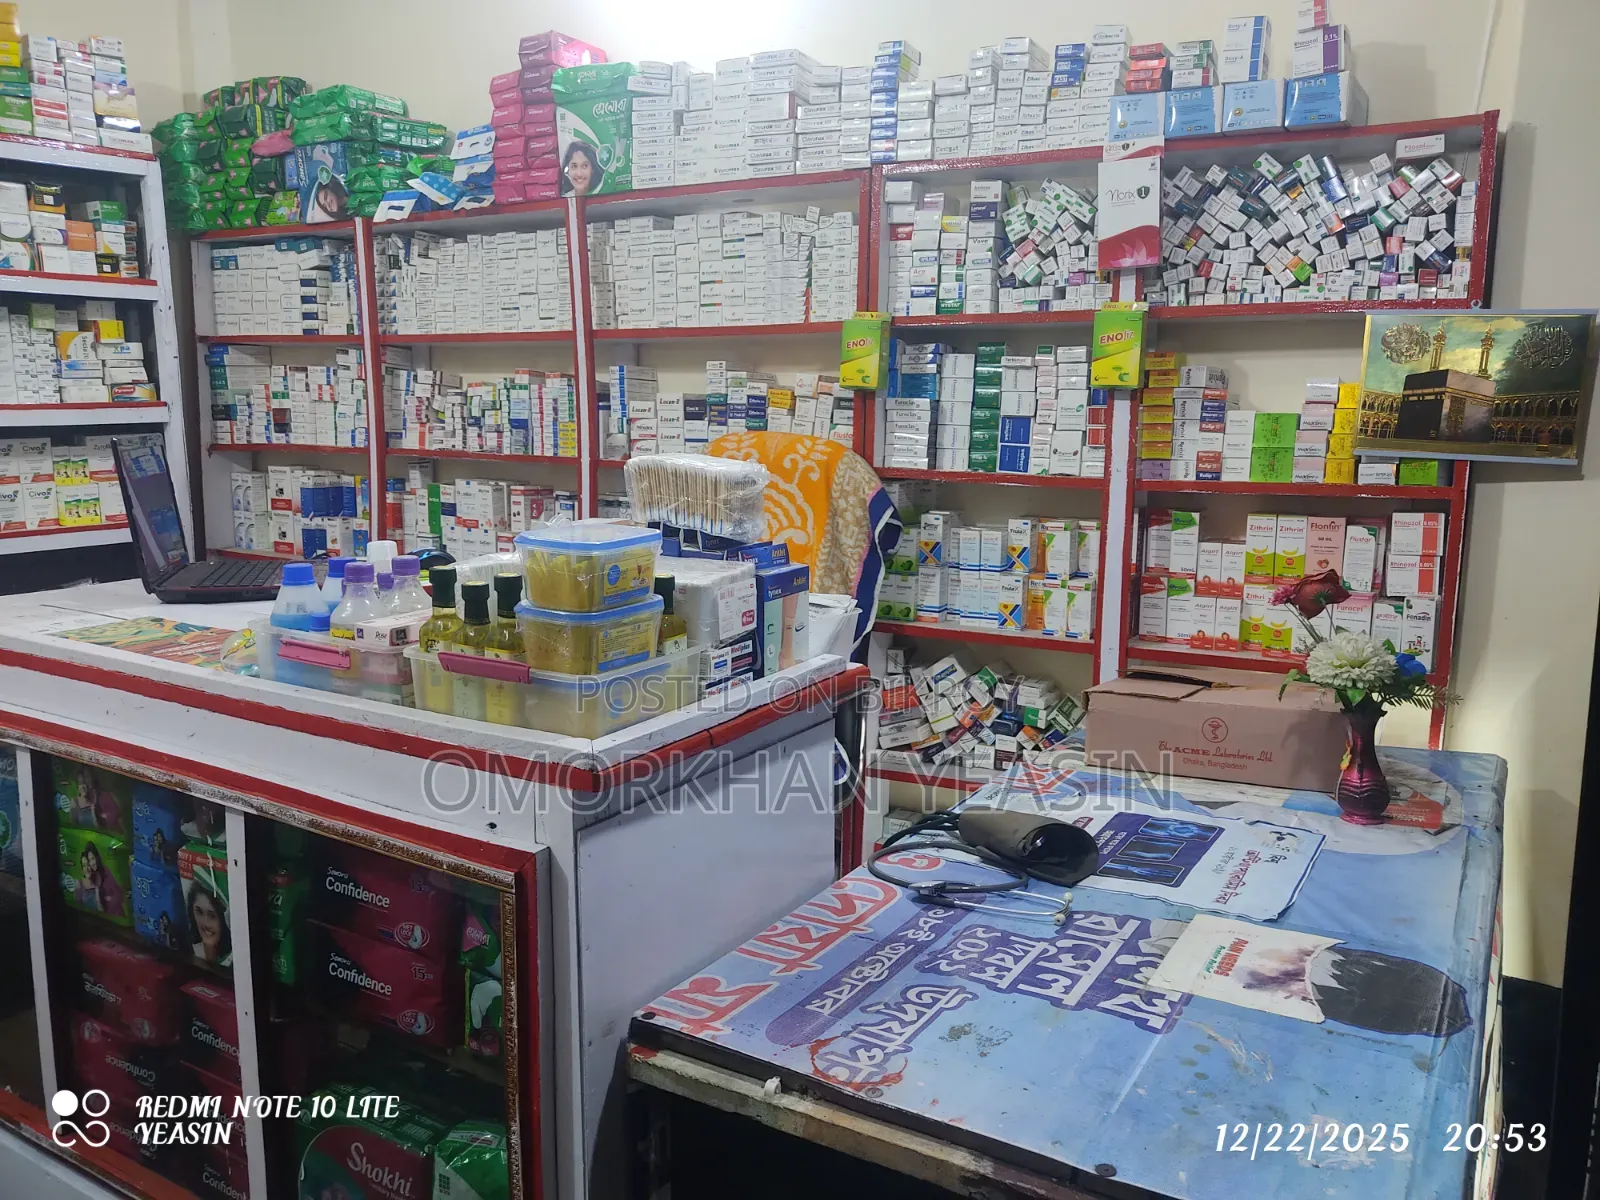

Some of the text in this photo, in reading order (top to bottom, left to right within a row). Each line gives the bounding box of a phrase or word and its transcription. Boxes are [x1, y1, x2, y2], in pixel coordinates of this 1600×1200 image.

[1294, 38, 1318, 47] Rhinozol
[22, 444, 46, 452] Civox
[833, 431, 852, 439] Flusta
[28, 490, 52, 498] Civox
[1249, 524, 1273, 532] Zithrin
[768, 588, 782, 599] tynex
[1406, 614, 1432, 622] Fenadin
[1173, 747, 1210, 757] ACME
[1212, 747, 1255, 761] Laboratories
[1208, 759, 1248, 771] Bangladesh
[326, 877, 390, 908] Confidence
[925, 927, 1001, 972] ২০২২
[968, 936, 1057, 989] দিবস
[1017, 913, 1141, 1006] রাসেল
[1213, 937, 1249, 977] PAIN NEEDS
[329, 963, 392, 995] Confidence
[805, 943, 914, 1016] অক্টোবর
[106, 1055, 155, 1082] Confidence
[346, 1142, 412, 1195] Shokhi
[202, 1171, 248, 1200] Confiden
